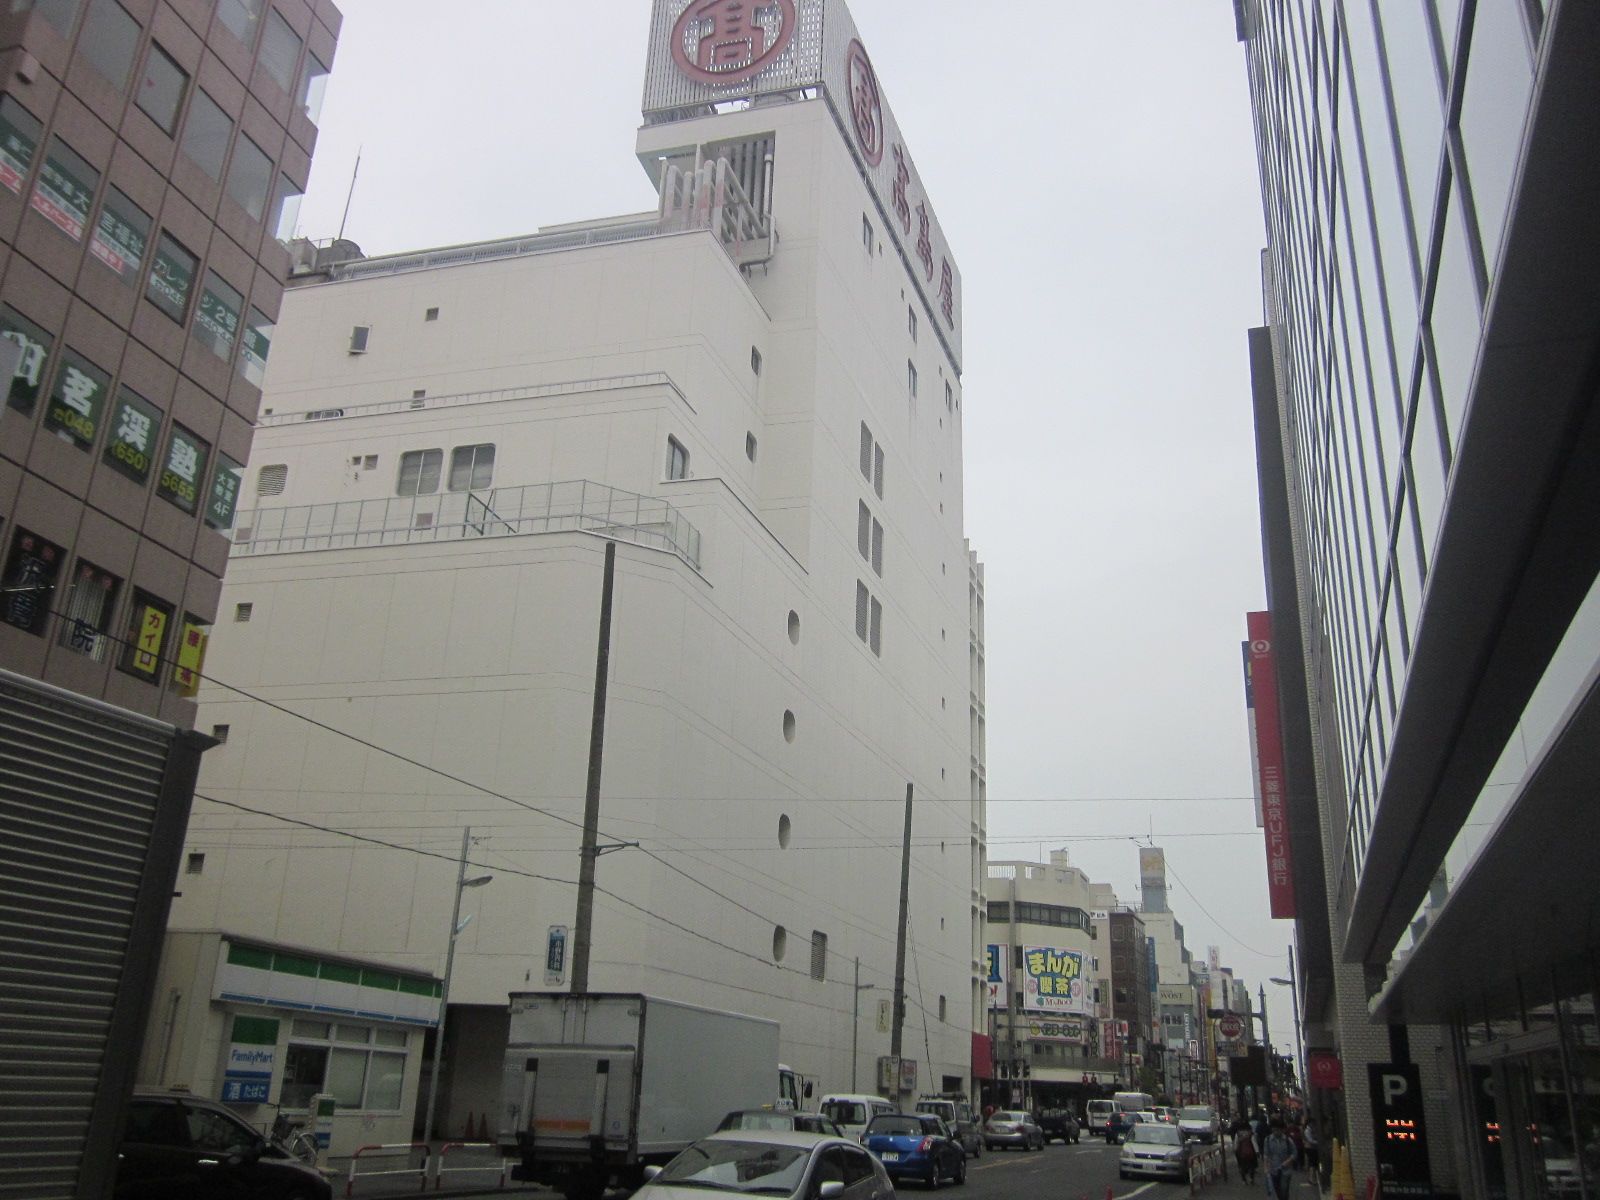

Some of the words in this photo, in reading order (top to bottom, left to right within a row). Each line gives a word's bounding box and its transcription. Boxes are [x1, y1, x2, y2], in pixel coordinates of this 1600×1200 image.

[1263, 765, 1288, 886] 三菱東京UFJ銀行
[1028, 951, 1080, 977] まんが
[231, 1049, 273, 1065] FamilyMart
[244, 1084, 267, 1098] たばこ
[1381, 1074, 1408, 1106] P
